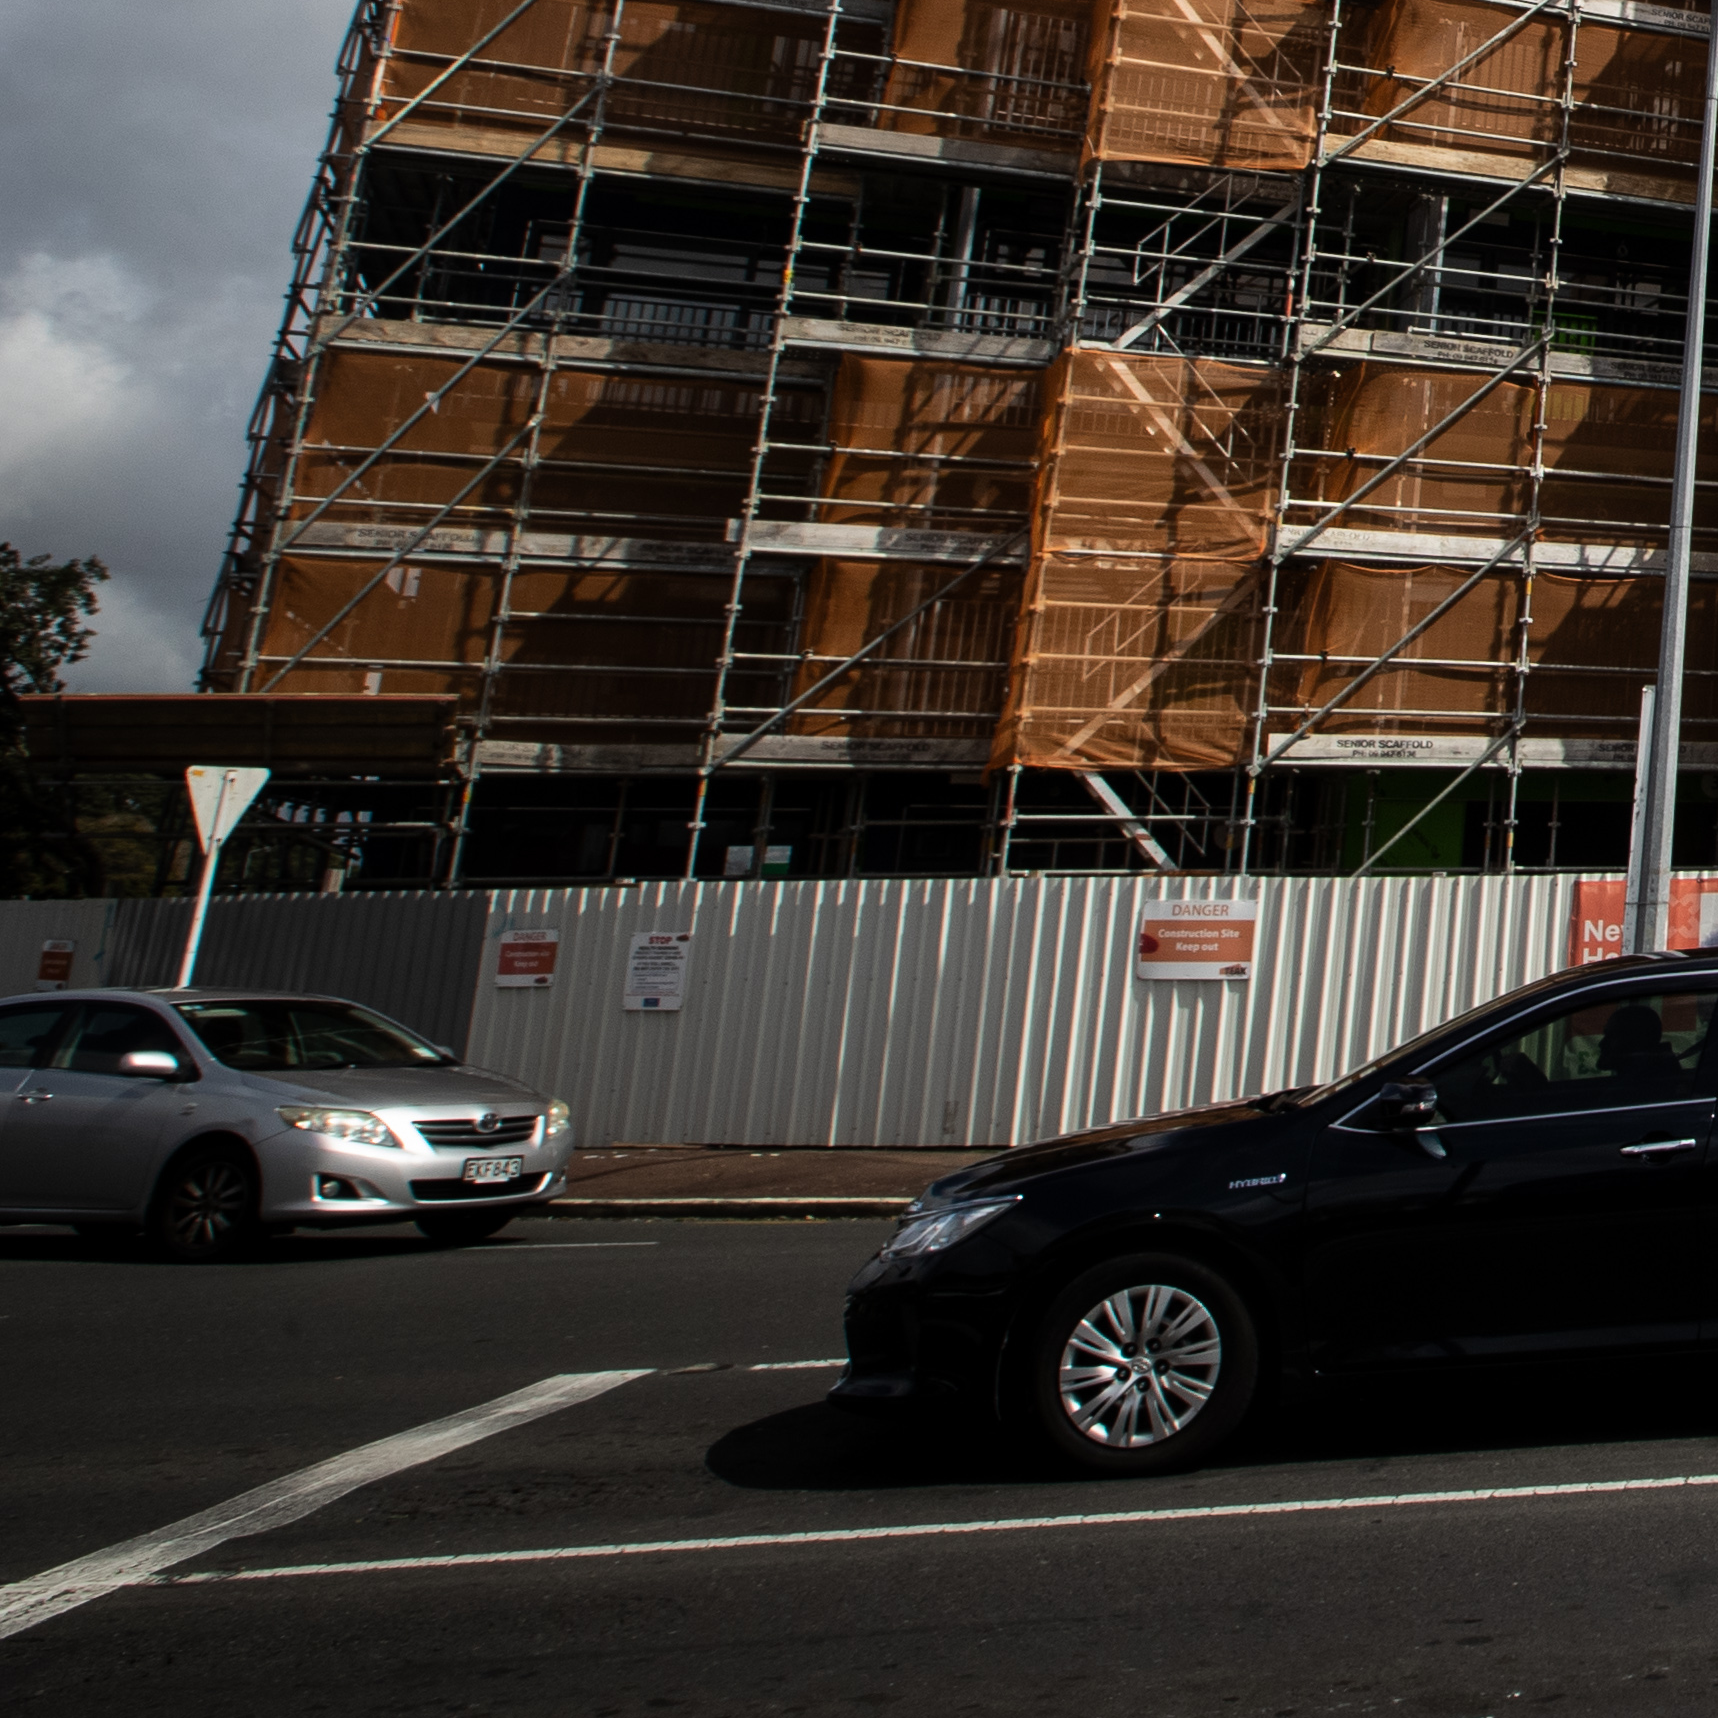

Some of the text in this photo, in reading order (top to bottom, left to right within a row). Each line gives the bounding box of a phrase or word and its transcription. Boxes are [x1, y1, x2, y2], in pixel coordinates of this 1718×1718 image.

[1651, 10, 1685, 21] SENIOR
[1424, 340, 1514, 358] SENIOR SCAFFOLD
[1337, 740, 1433, 749] SENIOR SCAFFOLD
[1172, 905, 1229, 916] DANGER
[1158, 929, 1240, 938] Construction Site
[1584, 920, 1624, 942] Ne
[513, 932, 547, 941] DANGER
[649, 936, 672, 944] STOP
[1176, 943, 1218, 952] Keep out
